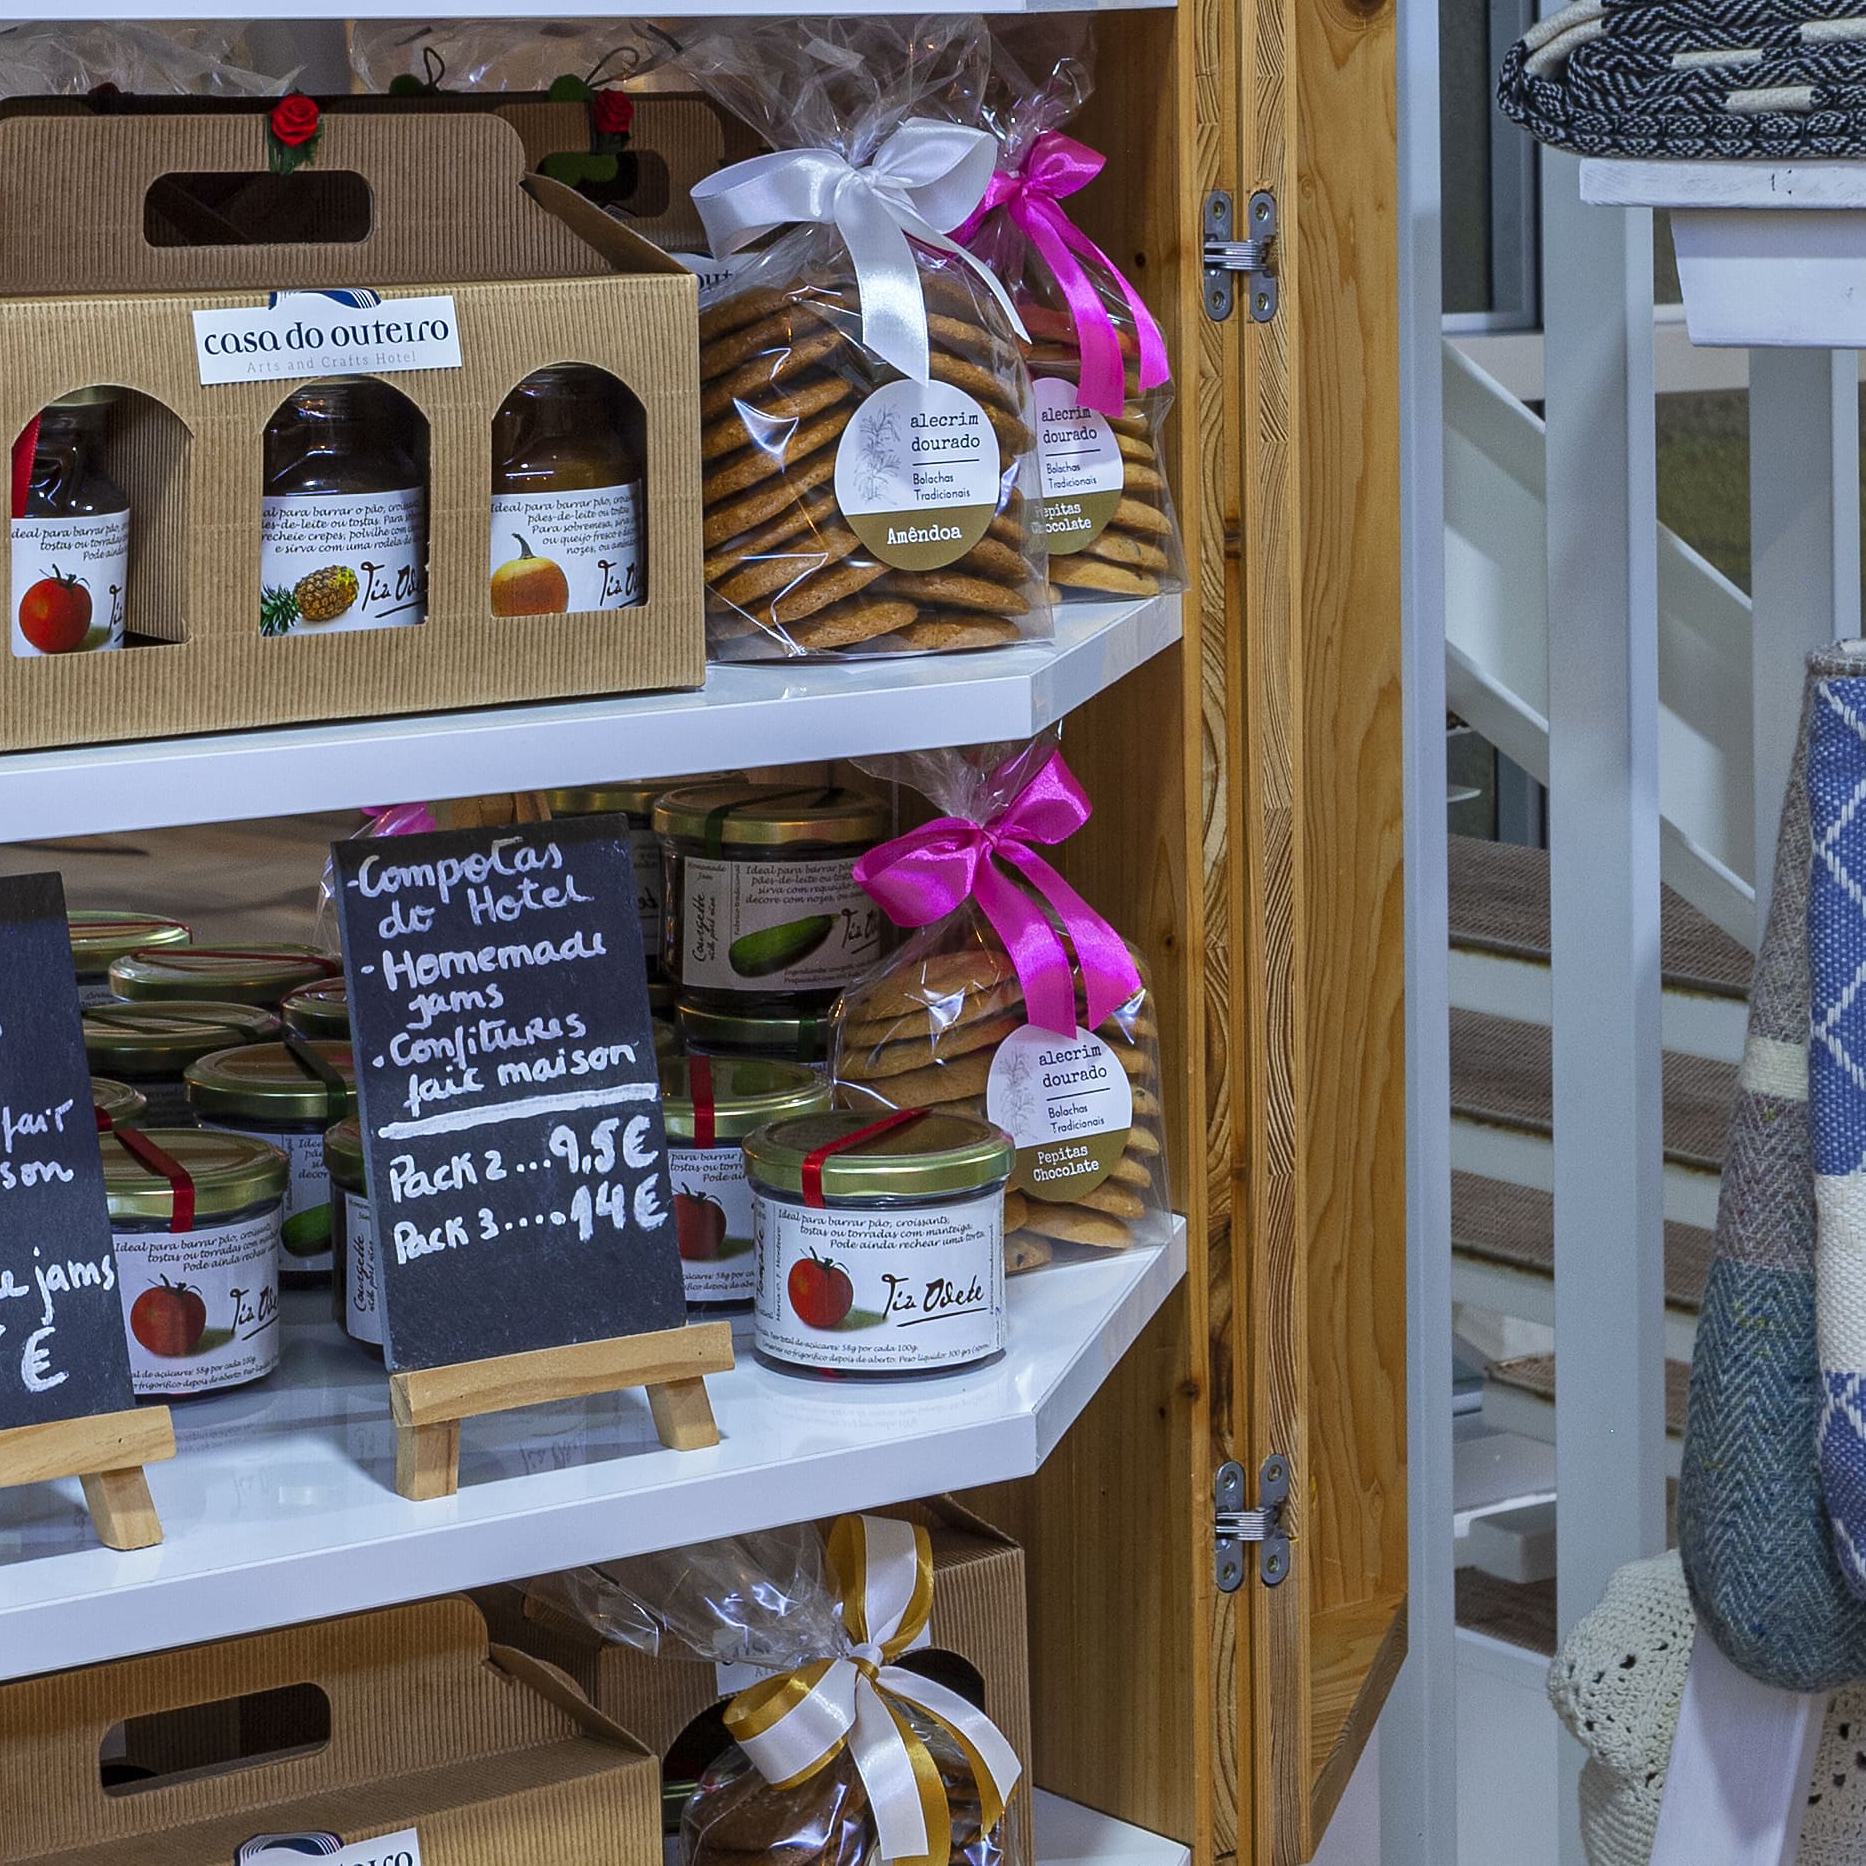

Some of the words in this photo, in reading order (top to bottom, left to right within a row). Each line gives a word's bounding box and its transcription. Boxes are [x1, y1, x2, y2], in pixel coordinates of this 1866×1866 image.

[204, 330, 280, 356] casa
[286, 322, 324, 350] do
[330, 318, 449, 347] outeiro
[246, 360, 280, 374] Arts
[288, 357, 314, 371] and
[321, 353, 368, 368] Crafts
[376, 350, 417, 366] Hotel
[910, 412, 979, 428] alecrim
[1041, 406, 1092, 423] alecrim
[911, 434, 980, 452] dourado
[1043, 426, 1097, 445] dourado
[912, 473, 954, 485] Bolachas
[1046, 462, 1081, 475] Bolachas
[1049, 475, 1097, 489] Tradicionais
[914, 487, 971, 501] Tradicionais
[887, 523, 962, 546] Amêndoa
[361, 561, 391, 612] Tia
[467, 874, 595, 926] Hotel
[406, 983, 505, 1031] jams
[1039, 1044, 1102, 1066] alecrim
[403, 1065, 484, 1118] fait
[498, 1042, 639, 1087] maison
[1043, 1065, 1107, 1088] dourado
[1048, 1102, 1088, 1119] Bolachas
[2, 1098, 74, 1154] fait
[1050, 1116, 1105, 1134] Tradicionais
[389, 1152, 477, 1204] Pack
[548, 1114, 659, 1175] 9,5€
[1037, 1145, 1089, 1165] Pepitas
[1033, 1158, 1100, 1183] Chocolate
[392, 1216, 470, 1265] Pack
[570, 1172, 669, 1243] 14€
[828, 1216, 866, 1228] barrar
[34, 1245, 116, 1326] jams
[881, 1274, 917, 1320] Tia
[923, 1274, 984, 1312] Odete
